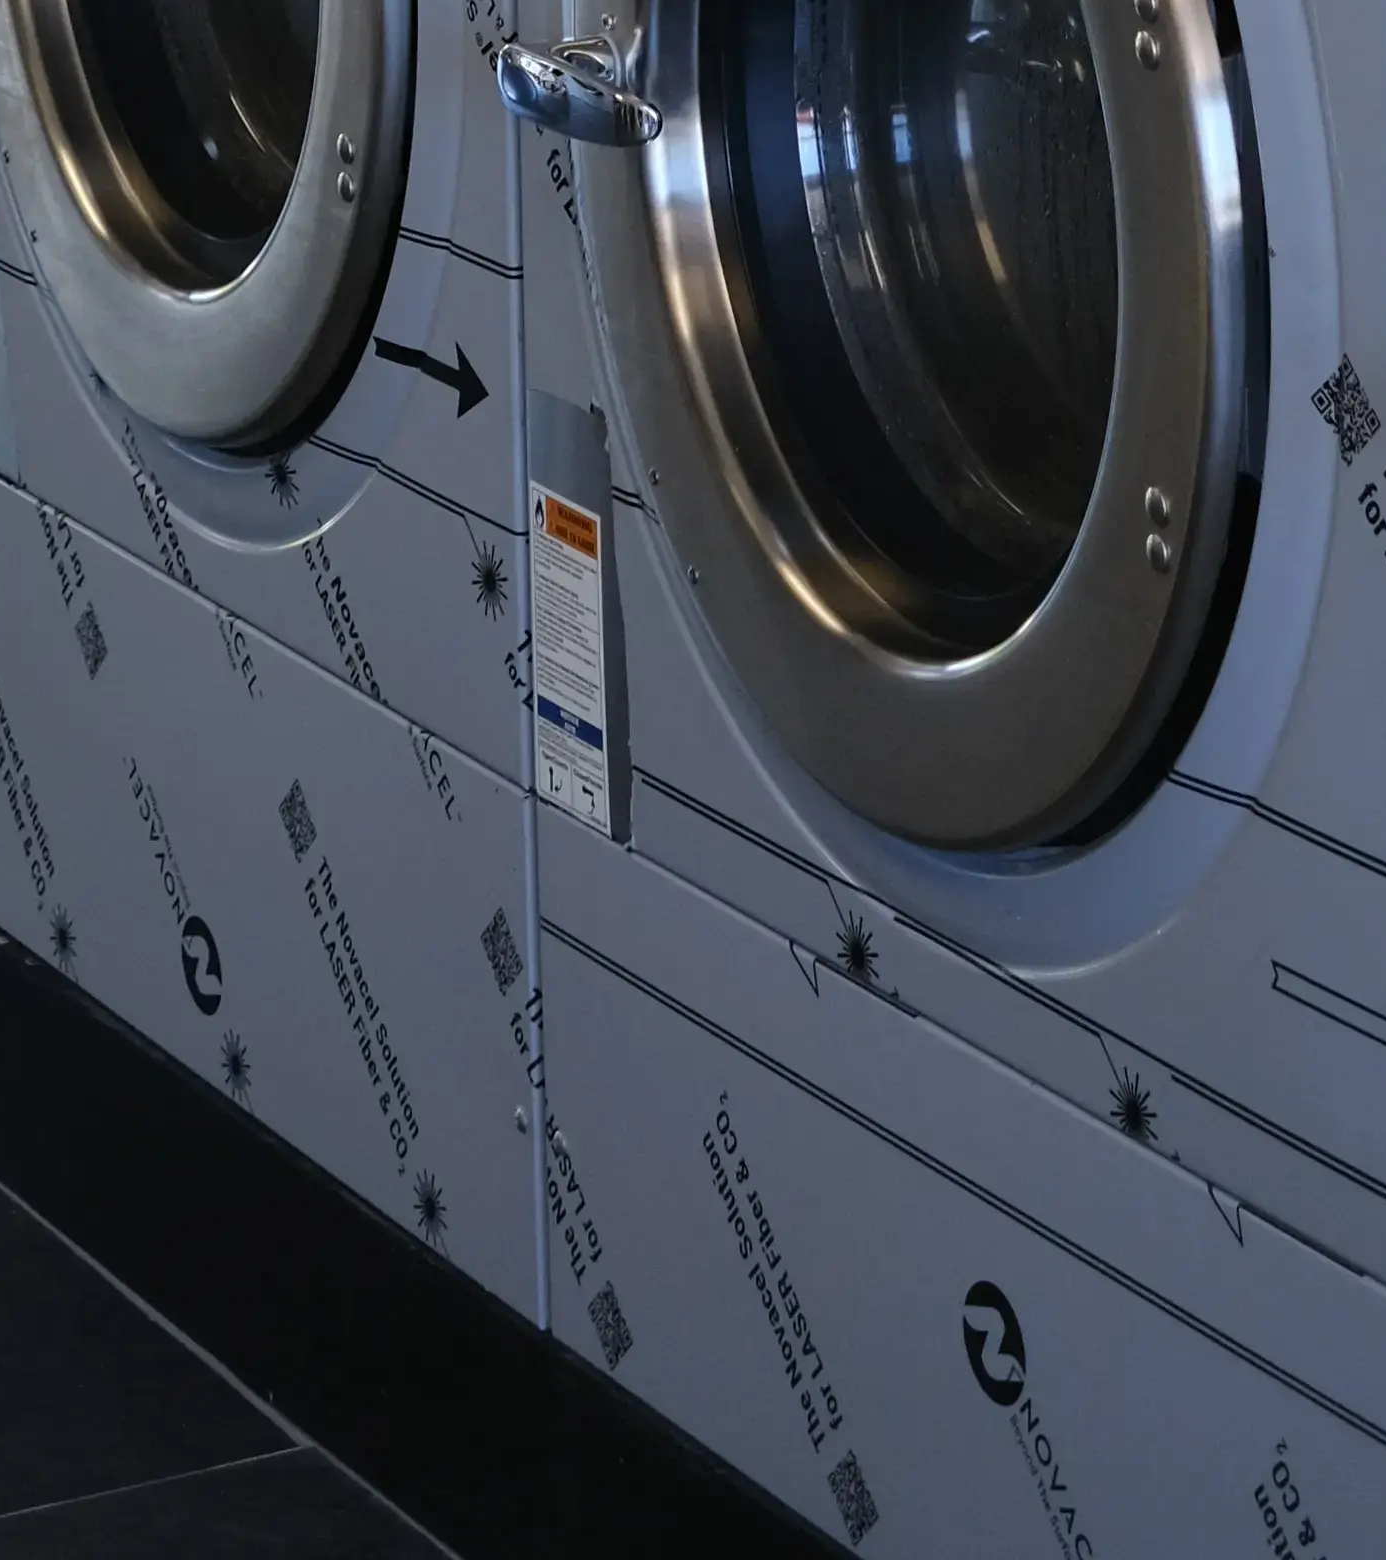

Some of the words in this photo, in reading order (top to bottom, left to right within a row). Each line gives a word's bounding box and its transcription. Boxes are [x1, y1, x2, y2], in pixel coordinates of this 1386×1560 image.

[315, 575, 347, 654] LASER
[505, 652, 527, 689] for
[20, 775, 54, 878] Solution
[304, 878, 322, 919] for
[319, 921, 356, 1016] LASER
[353, 1015, 382, 1088] Fiber
[379, 1092, 391, 1116] &
[318, 856, 338, 911] The
[336, 911, 380, 1021] Novacel
[376, 1023, 420, 1140] Solution
[511, 1012, 529, 1056] for
[702, 1130, 753, 1261] Solution
[734, 1157, 749, 1184] &
[564, 1224, 587, 1287] The
[583, 1219, 603, 1264] for
[747, 1189, 782, 1271] Fiber
[748, 1262, 802, 1390] Novacel
[778, 1271, 824, 1380] LASER
[800, 1389, 827, 1454] The
[819, 1381, 844, 1432] for
